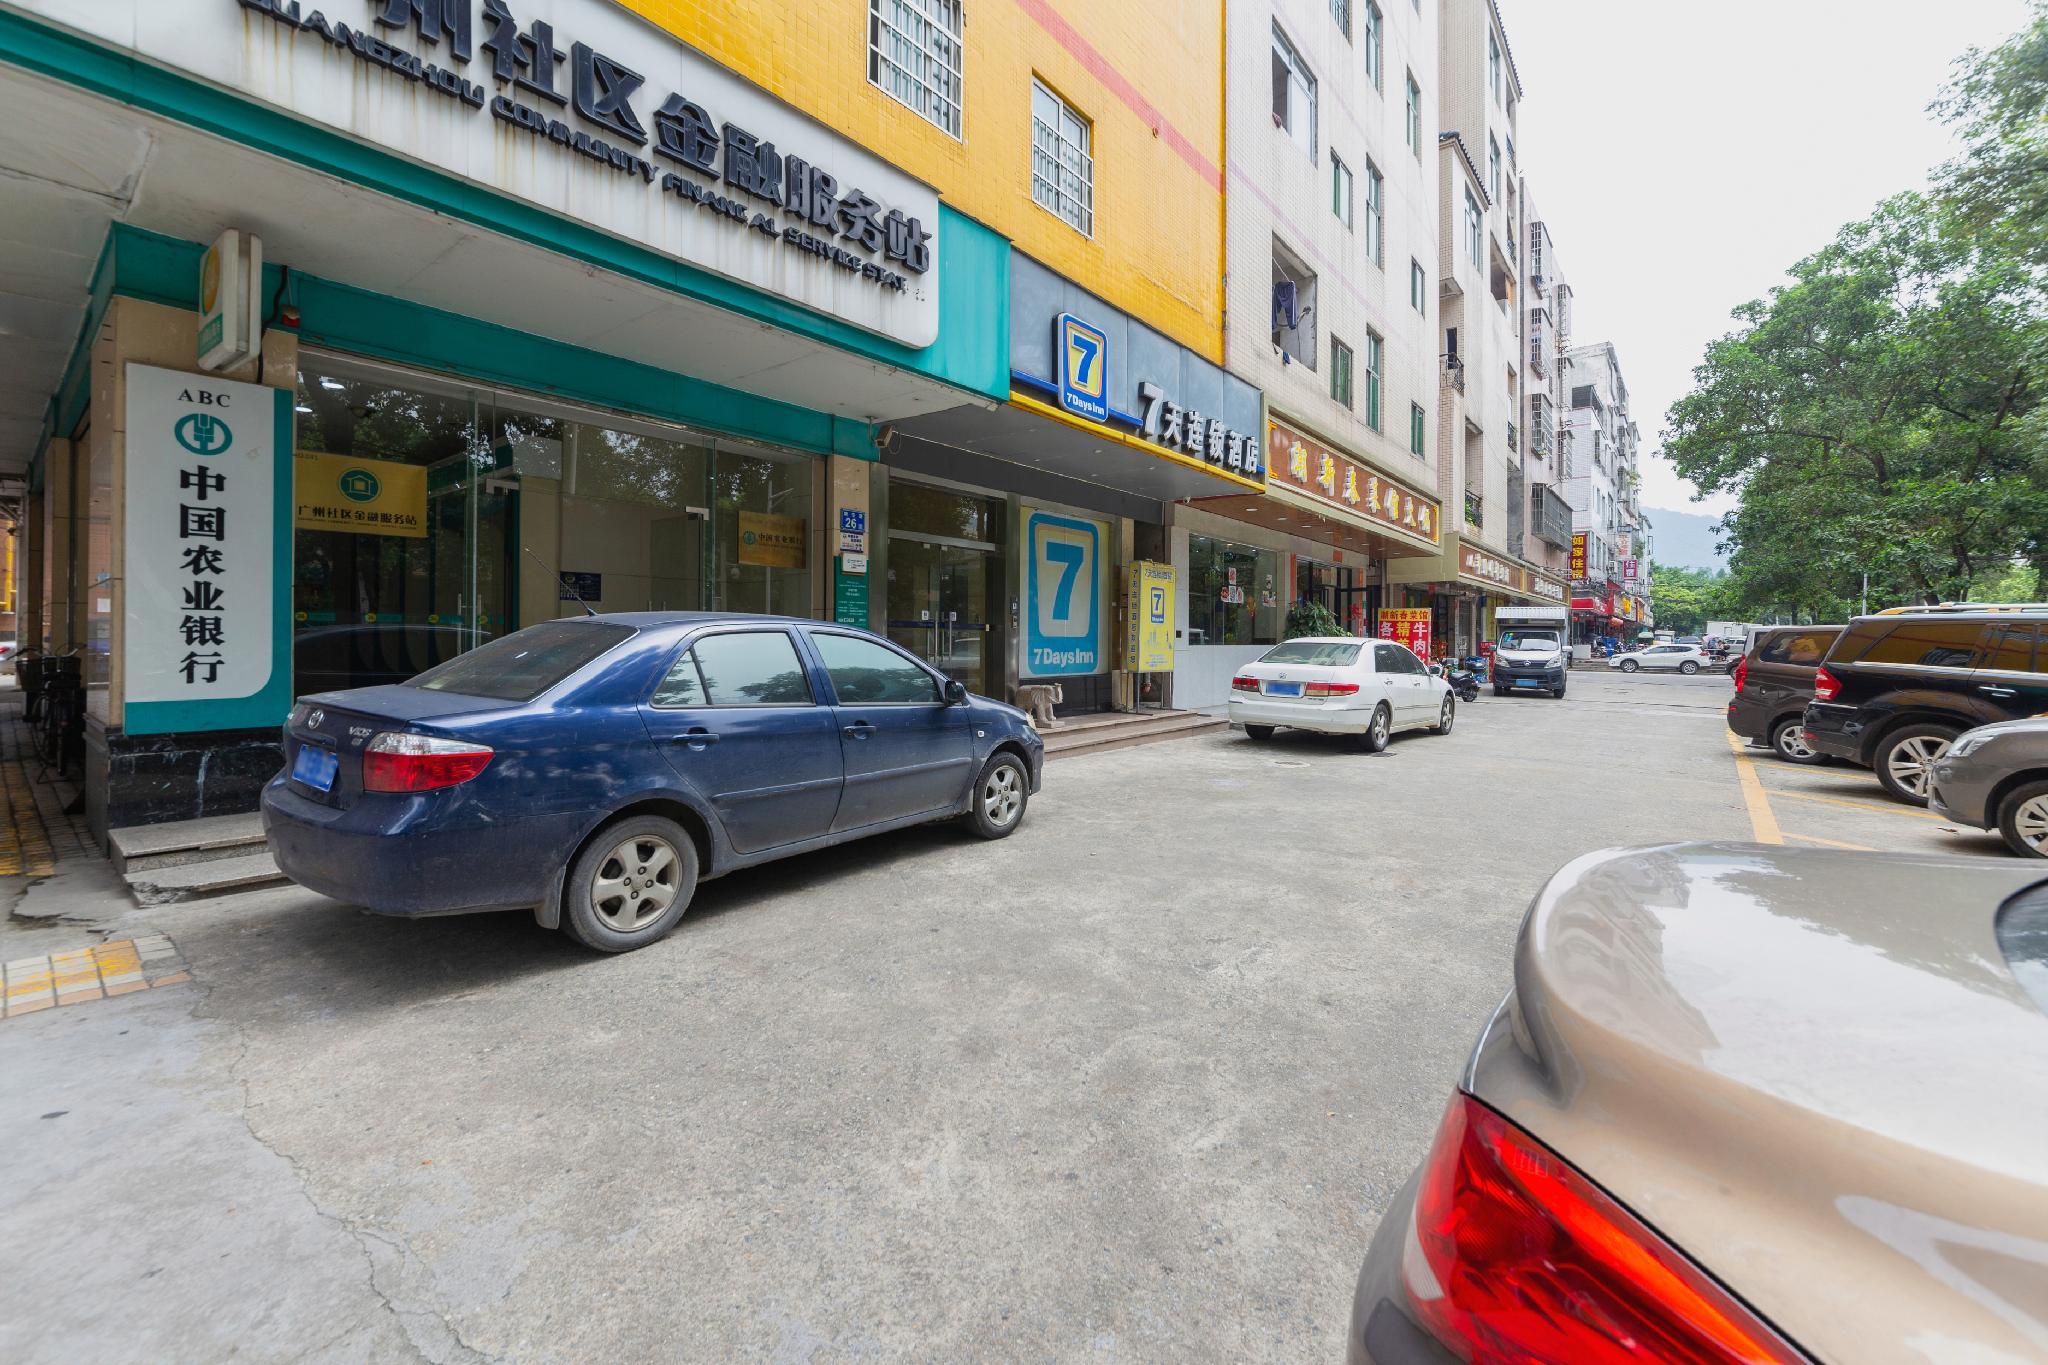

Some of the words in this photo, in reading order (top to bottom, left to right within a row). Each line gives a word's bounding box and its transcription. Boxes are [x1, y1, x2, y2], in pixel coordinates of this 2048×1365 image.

[490, 95, 660, 184] COMMUNITY
[782, 226, 862, 273] SERVICE
[1072, 333, 1099, 386] 7
[178, 388, 232, 408] ABC
[1138, 381, 1260, 474] 7天连锁酒店
[298, 504, 418, 525] 广州社区金融服务站
[845, 517, 857, 529] 26
[178, 465, 228, 685] 中国农业银行
[1046, 541, 1084, 621] 7
[1153, 593, 1162, 611] 7
[1412, 621, 1428, 662] 牛肉
